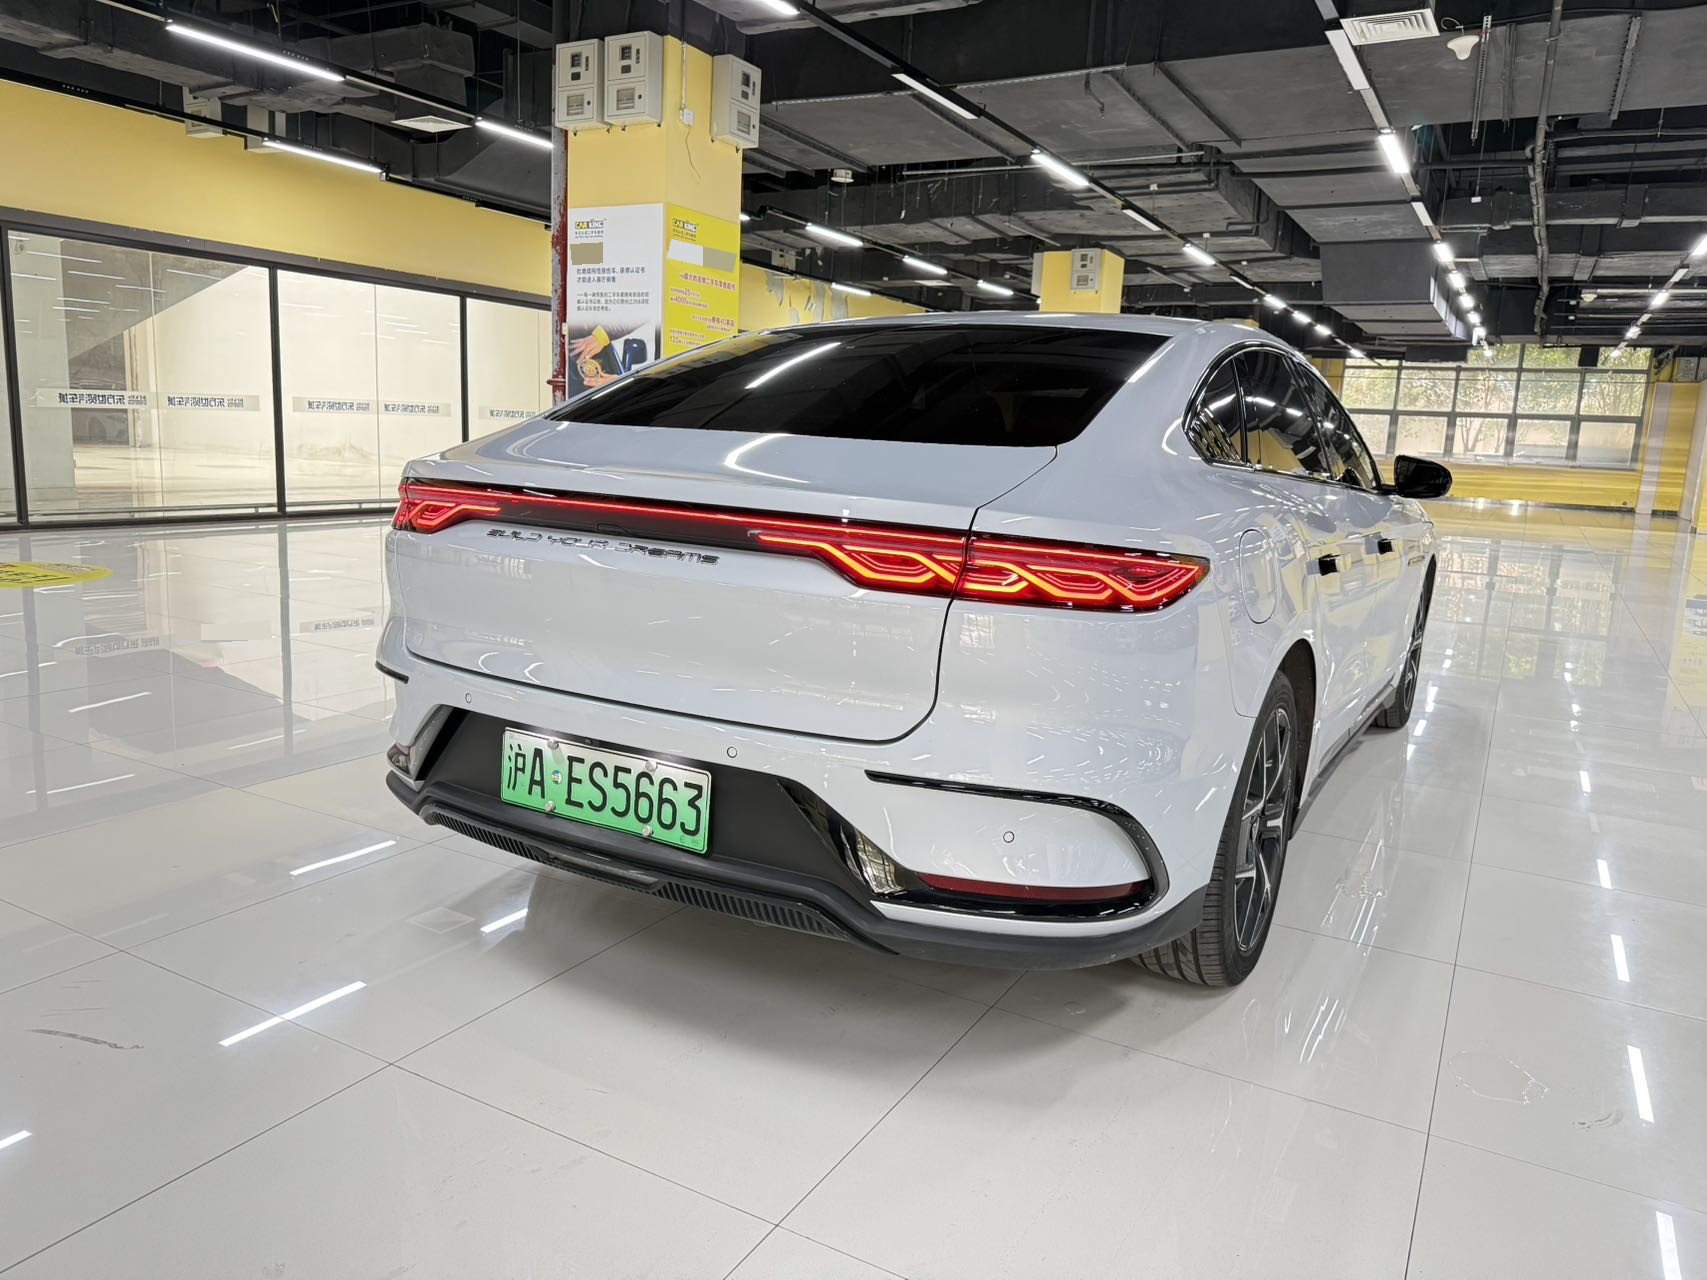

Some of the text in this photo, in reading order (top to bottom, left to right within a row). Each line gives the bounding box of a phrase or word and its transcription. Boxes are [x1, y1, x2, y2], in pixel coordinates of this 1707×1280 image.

[486, 528, 721, 566] BUILD YOUR DREAMS
[565, 755, 704, 837] ES5663
